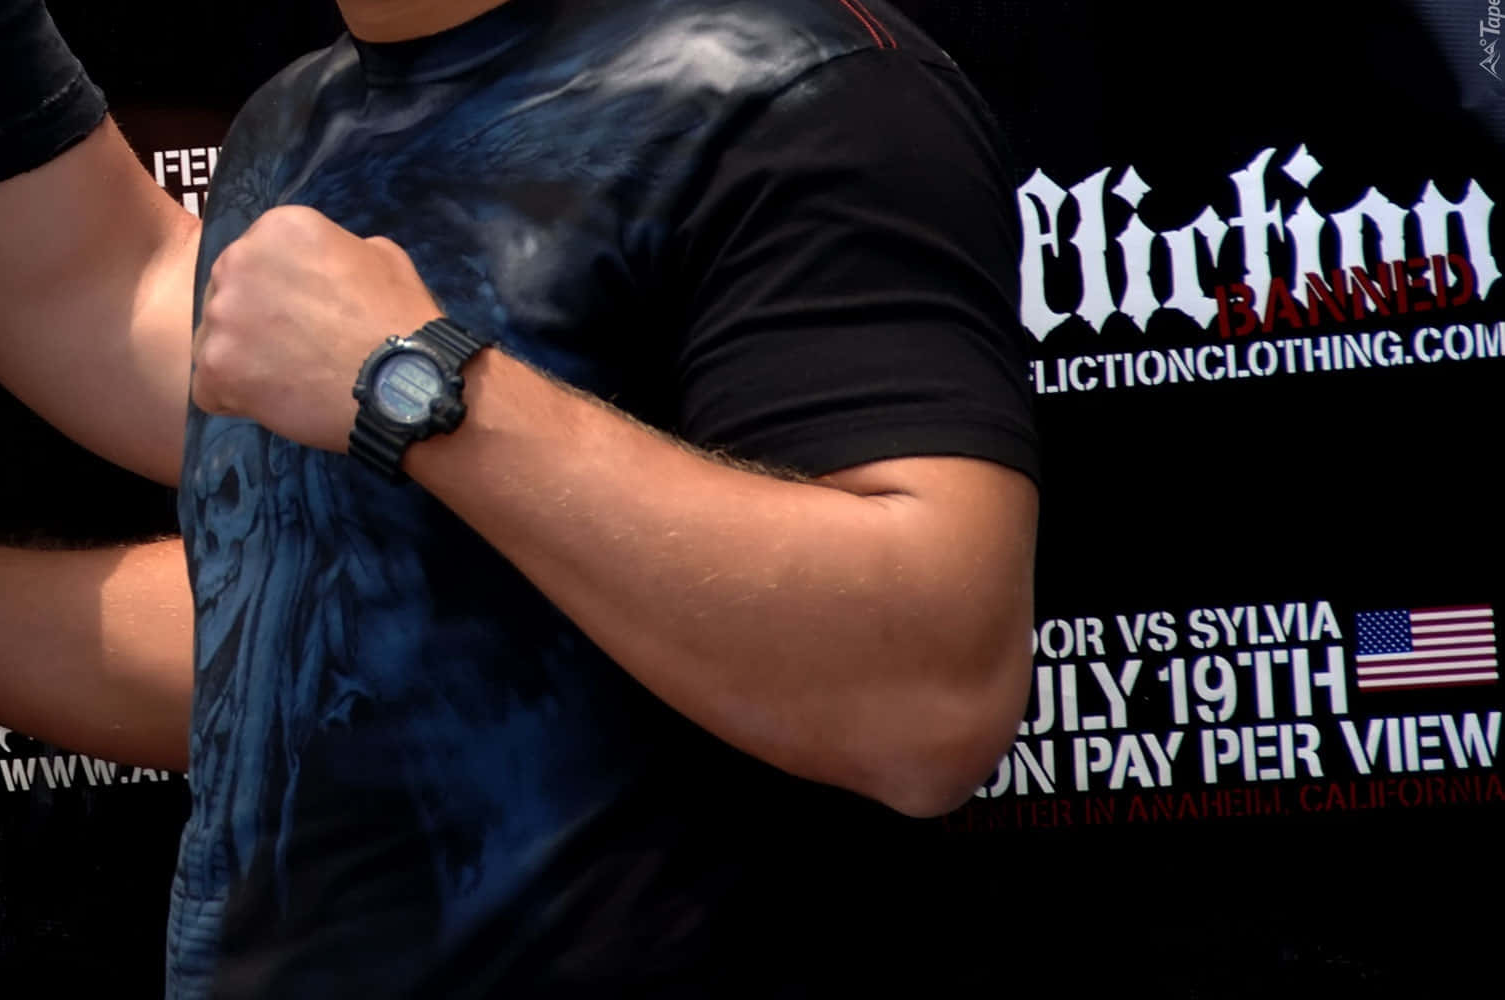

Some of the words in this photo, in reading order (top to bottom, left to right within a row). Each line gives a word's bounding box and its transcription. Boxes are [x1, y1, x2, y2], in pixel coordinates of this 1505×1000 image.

[1017, 143, 1502, 343] fliction
[1214, 255, 1475, 338] BANNED
[1029, 322, 1505, 394] LICTIONCLOTHING.COM
[1116, 611, 1178, 654] VS
[1189, 601, 1342, 649] SYLVIA
[1018, 659, 1142, 735] ULY
[1157, 646, 1348, 724] 19TH
[1074, 731, 1185, 792] PAY
[1200, 722, 1323, 784] PER
[1340, 711, 1502, 775] VIEW
